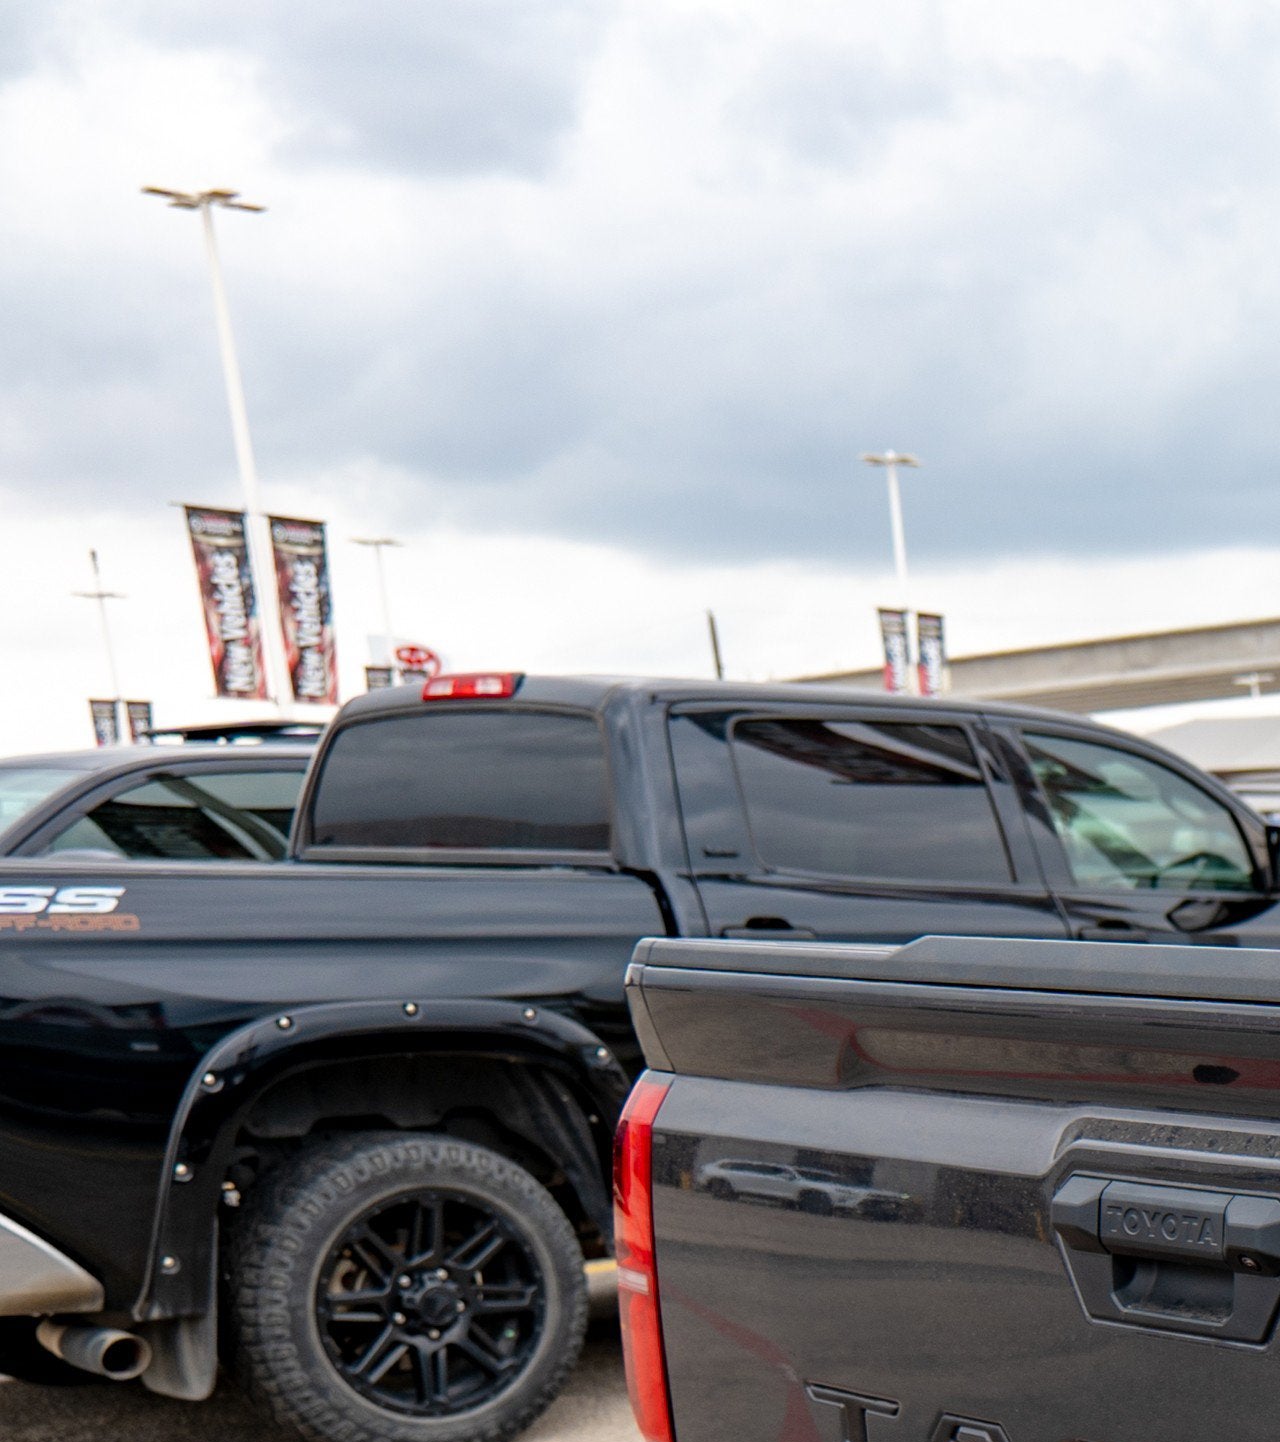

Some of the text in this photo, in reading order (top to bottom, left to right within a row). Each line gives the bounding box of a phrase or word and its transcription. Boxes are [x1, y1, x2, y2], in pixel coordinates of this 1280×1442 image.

[210, 551, 248, 640] Vehicles
[289, 560, 322, 647] Vehicles
[224, 640, 256, 692] New
[297, 648, 327, 697] New
[1106, 1204, 1218, 1247] TOYOTA
